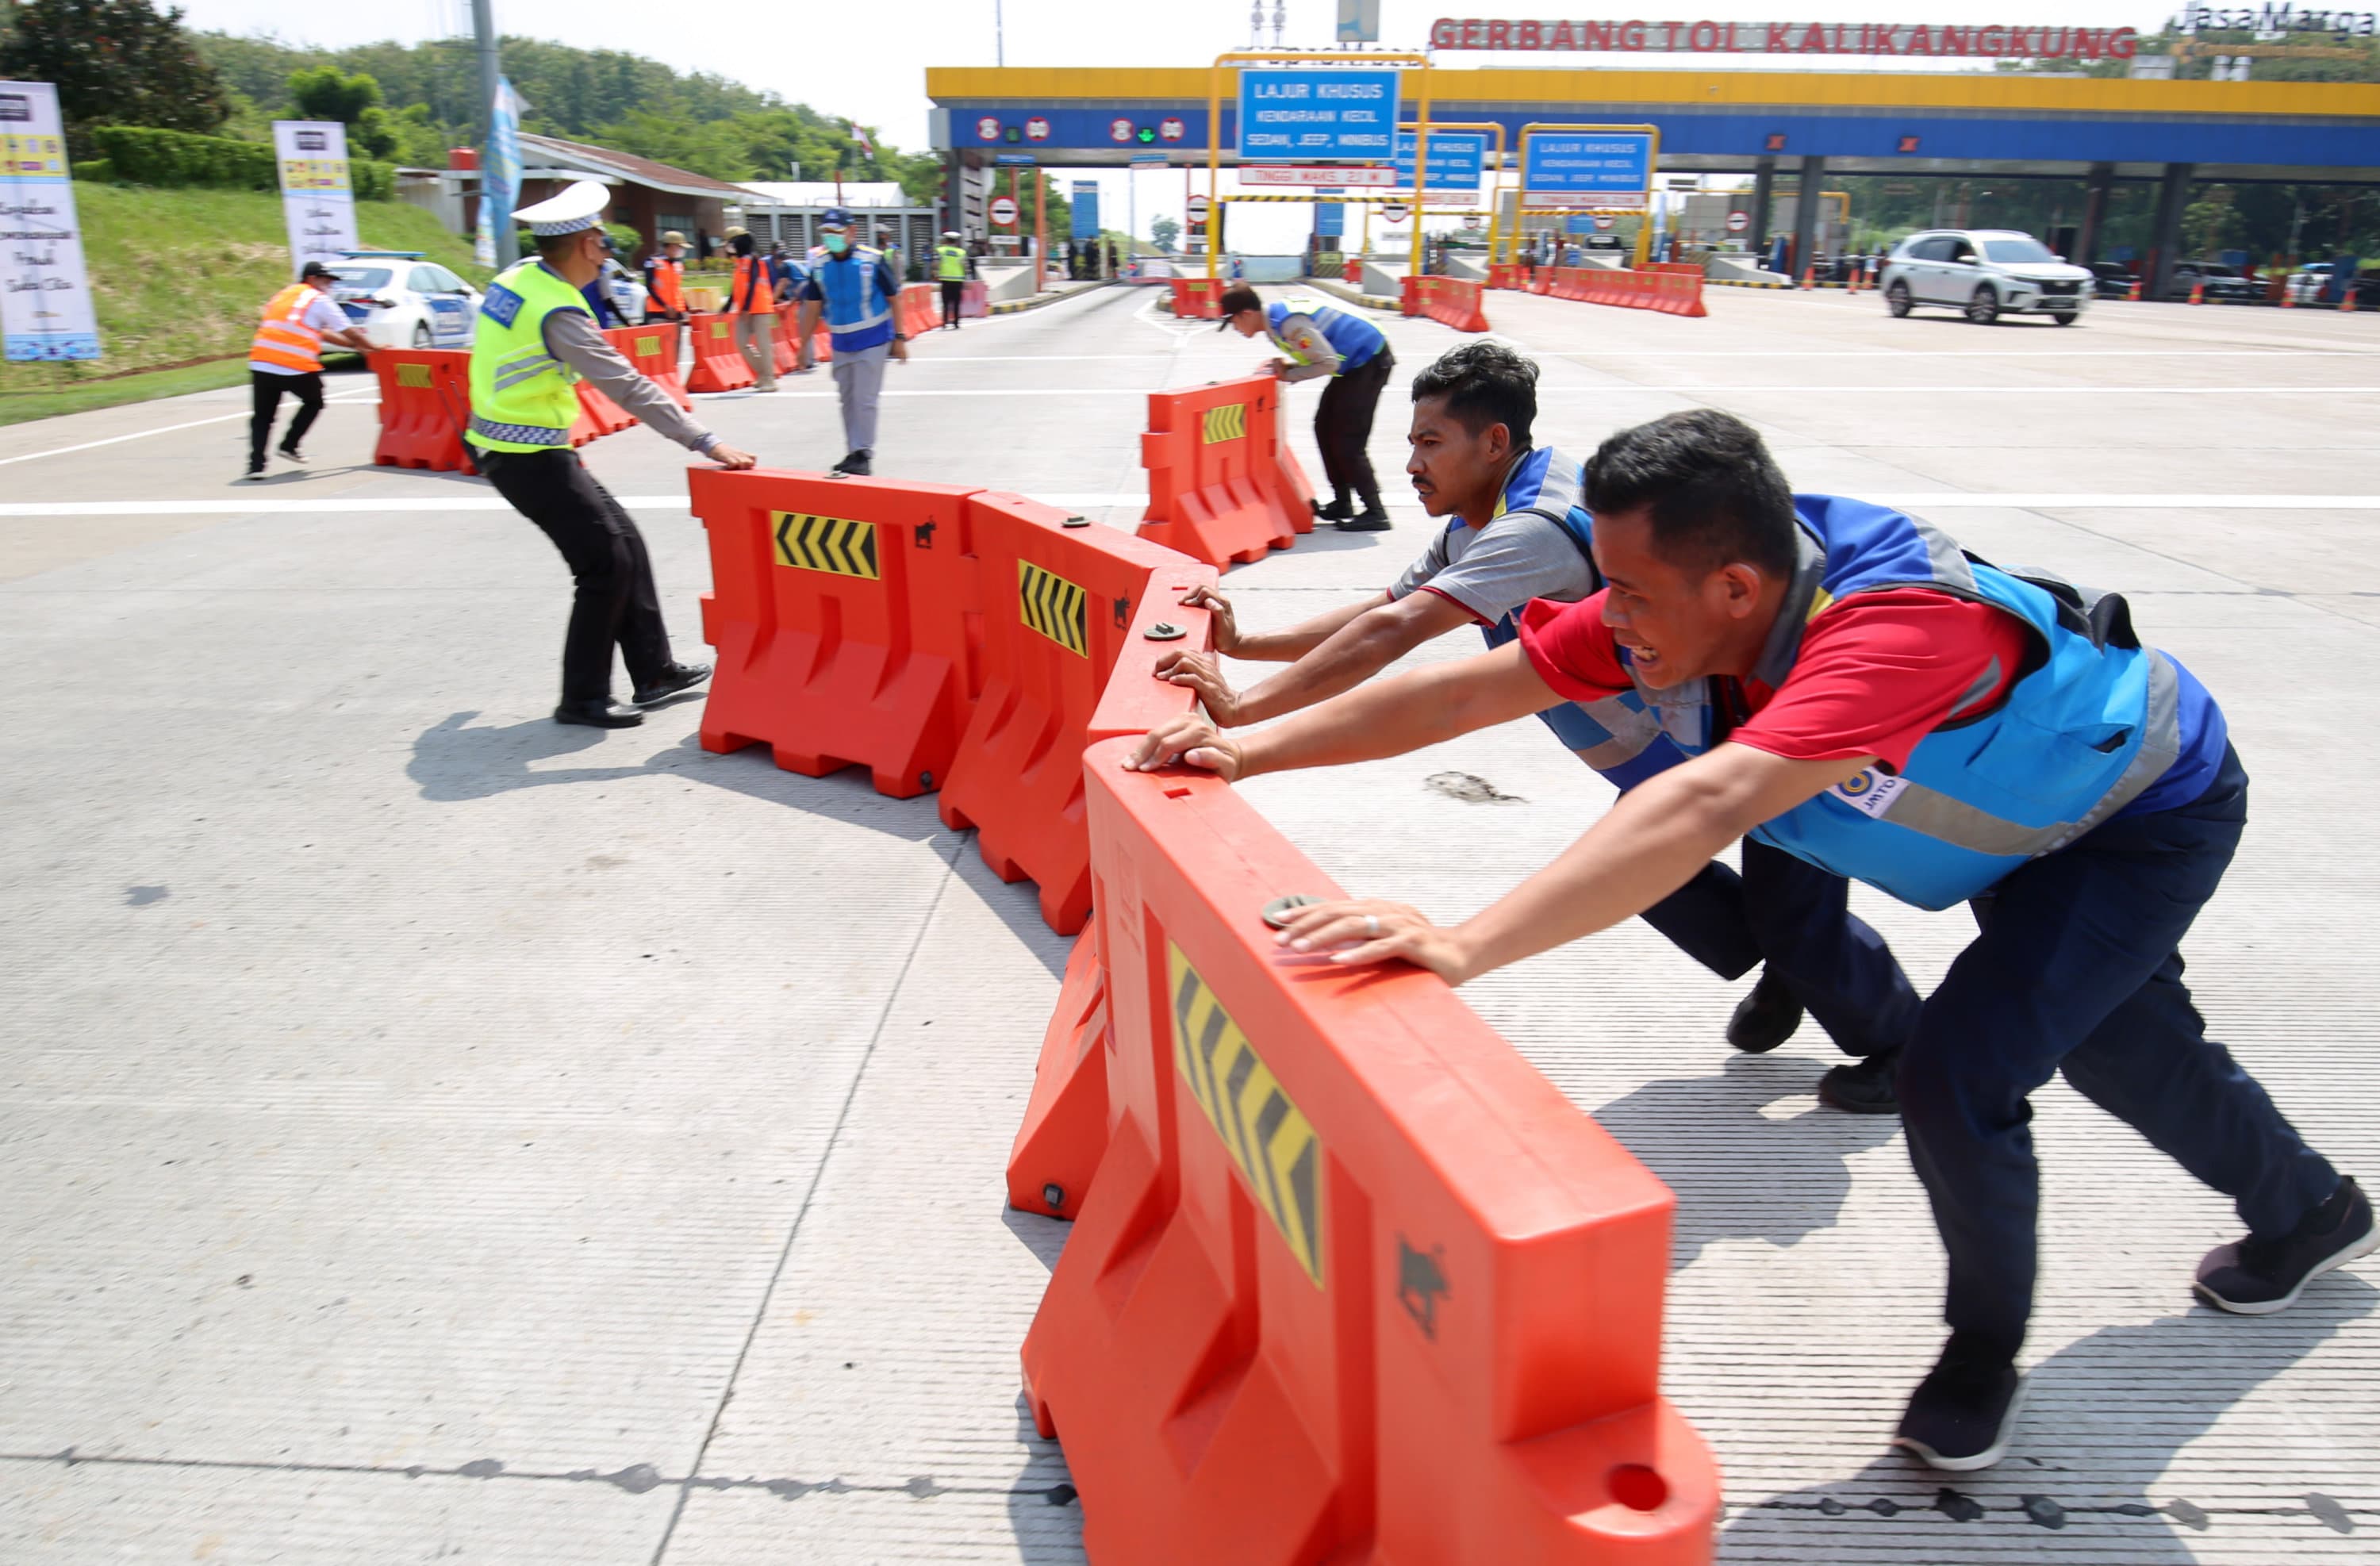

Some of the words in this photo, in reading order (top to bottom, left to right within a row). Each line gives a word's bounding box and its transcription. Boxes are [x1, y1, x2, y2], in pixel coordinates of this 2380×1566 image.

[1430, 18, 1646, 52] GERBANG
[1662, 21, 1746, 52] TOL
[1766, 22, 2137, 59] KALIKANGKUNG
[1253, 83, 1309, 98] LAJUR
[1316, 83, 1384, 98] KHUSUS
[1255, 110, 1337, 122] KENDARAAN
[1341, 110, 1379, 122] KECIL
[1246, 133, 1295, 148] SEDAN,
[1297, 133, 1335, 148] JEEP,
[1338, 134, 1389, 146] MINIBUS
[1539, 144, 1582, 153] LAJUR
[1584, 144, 1637, 153] KHUSUS
[1255, 170, 1294, 182] TINGGI
[1863, 779, 1897, 810] JMTO
